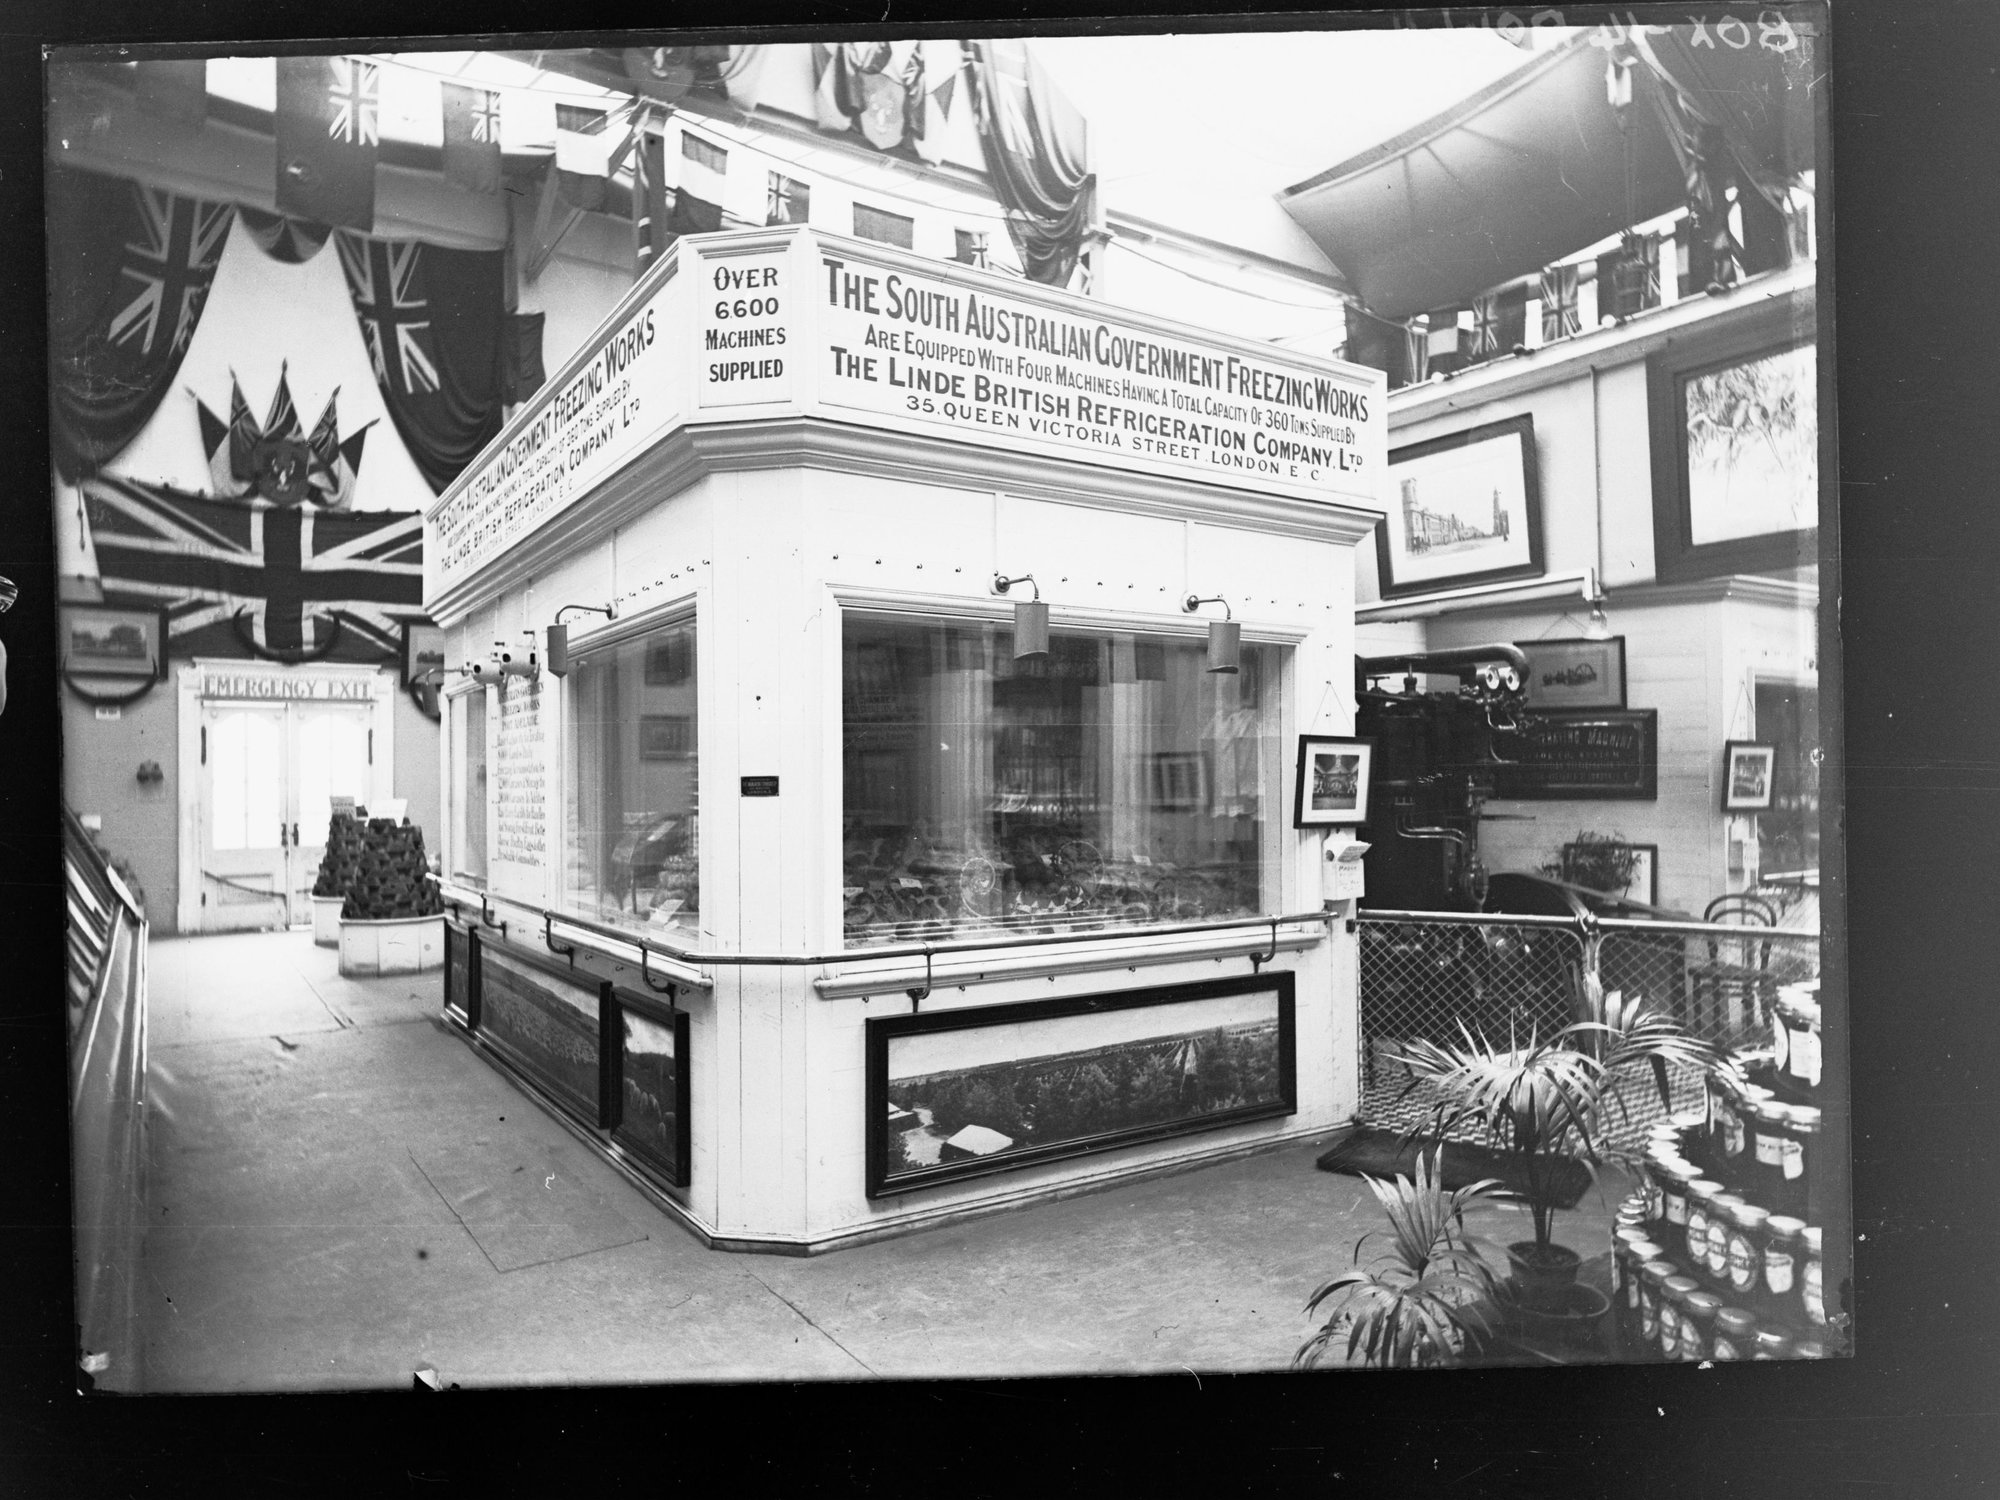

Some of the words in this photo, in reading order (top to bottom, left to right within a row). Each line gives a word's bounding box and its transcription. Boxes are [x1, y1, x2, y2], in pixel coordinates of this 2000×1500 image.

[713, 266, 778, 291] OVER
[705, 327, 786, 350] MACHINES
[709, 359, 783, 382] SUPPLIED
[822, 258, 880, 315] THE
[886, 275, 959, 333] SOUTH
[965, 294, 1091, 362] AUSTRALIAN
[1095, 325, 1224, 390] GOVERNMENT
[1227, 356, 1313, 410] FREEZING
[1315, 377, 1369, 422] WORKS
[465, 459, 505, 511] AUSTRALIAN
[505, 410, 551, 477] GOVERNMENT
[553, 360, 602, 433] FREEZING
[604, 307, 655, 383] WORKS
[830, 345, 878, 382] THE
[889, 357, 966, 399] LINDE
[974, 374, 1070, 419] BRITISH
[1077, 396, 1246, 452] REFRIGERATION
[865, 323, 900, 351] ARE
[904, 330, 975, 367] EQUIPPED
[978, 347, 1013, 376] WITH
[1017, 356, 1052, 384] FOUR
[1055, 364, 1121, 398] MACHINES
[1122, 380, 1160, 405] HAVING
[1161, 388, 1168, 406] A
[1171, 389, 1203, 414] TOTAL
[1205, 396, 1248, 423] CAPACITY
[1251, 406, 1263, 426] OF
[1265, 409, 1288, 431] 360
[1290, 414, 1310, 436] TONS
[1311, 418, 1345, 442] SUPPLIED
[1346, 426, 1356, 445] BY
[943, 401, 1020, 429] QUEEN
[1029, 417, 1122, 448] VICTORIA
[504, 463, 565, 521] REFRIGERATION
[568, 418, 614, 471] COMPANY
[204, 675, 317, 698] EMERGENCY
[328, 681, 371, 699] EXIT
